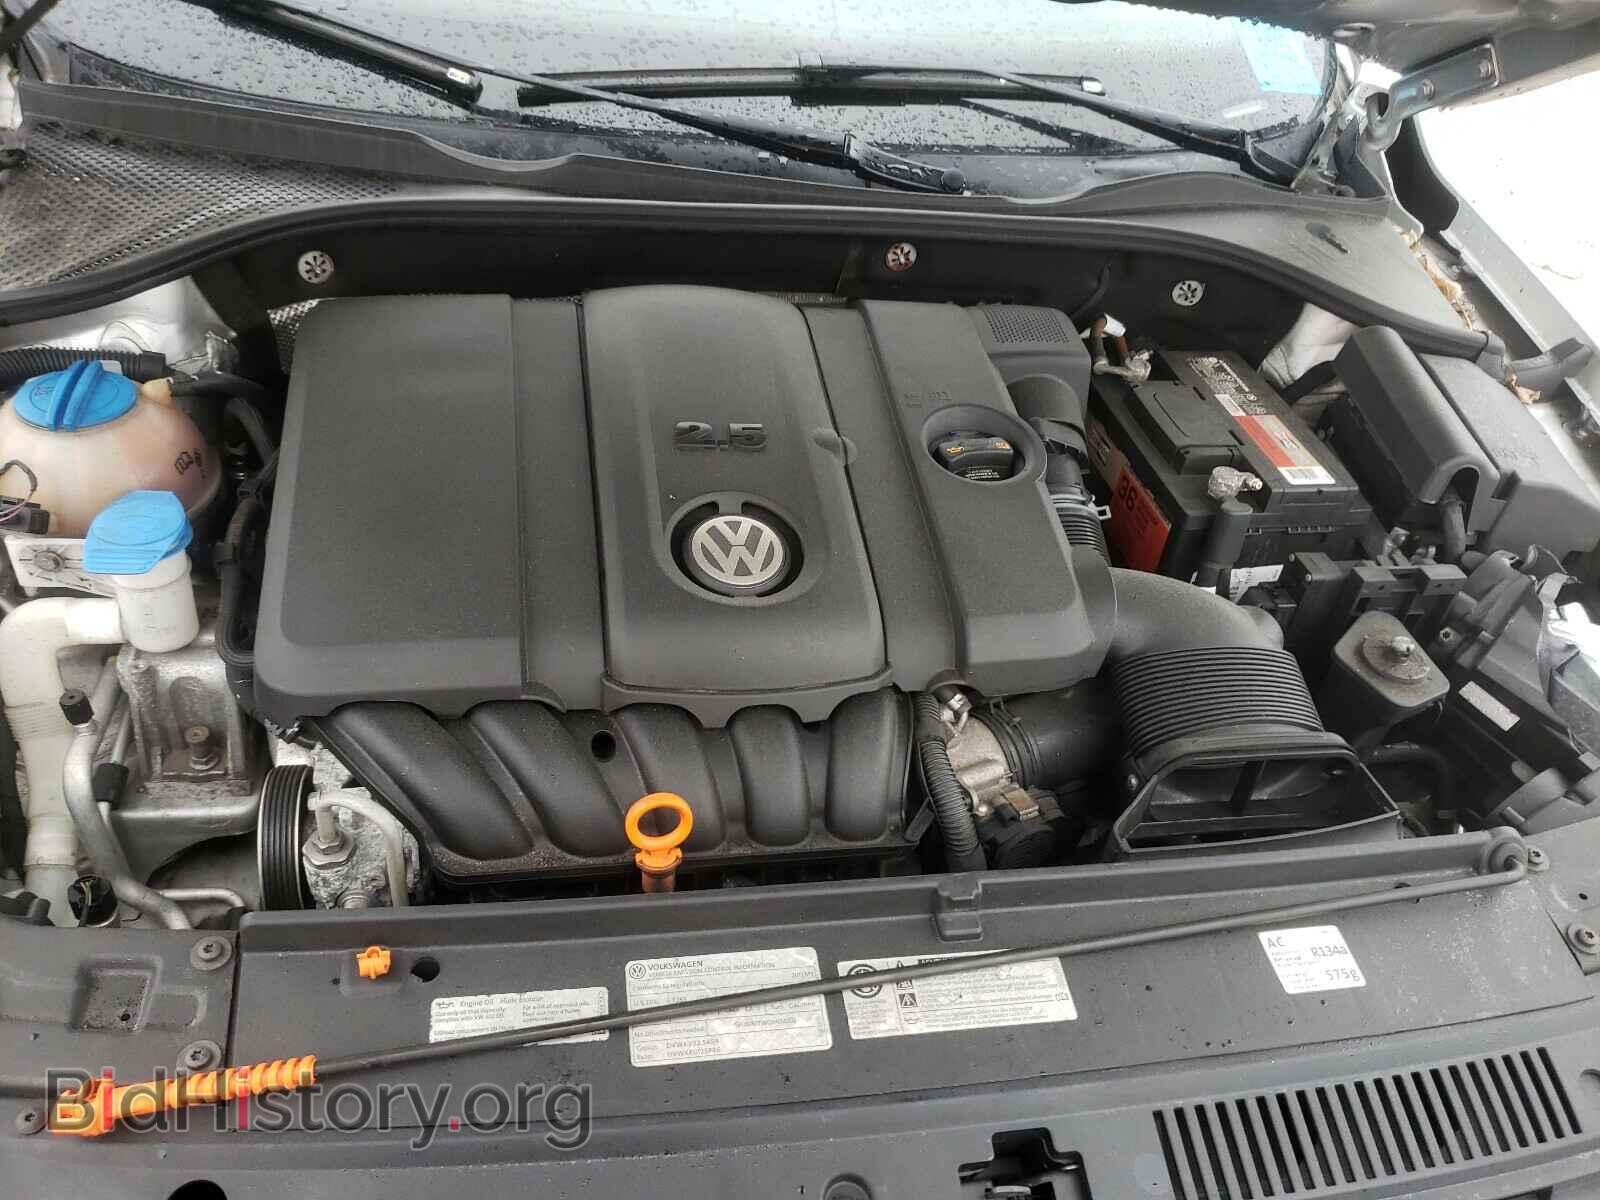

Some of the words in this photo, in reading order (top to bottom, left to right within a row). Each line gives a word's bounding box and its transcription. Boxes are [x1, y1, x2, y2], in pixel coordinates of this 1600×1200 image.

[674, 421, 768, 450] 2.5
[1268, 936, 1286, 948] AC
[1310, 945, 1349, 957] R134a
[648, 961, 703, 971] VOLKSWAGEN
[1325, 968, 1360, 982] 575g
[460, 1000, 483, 1008] Engine
